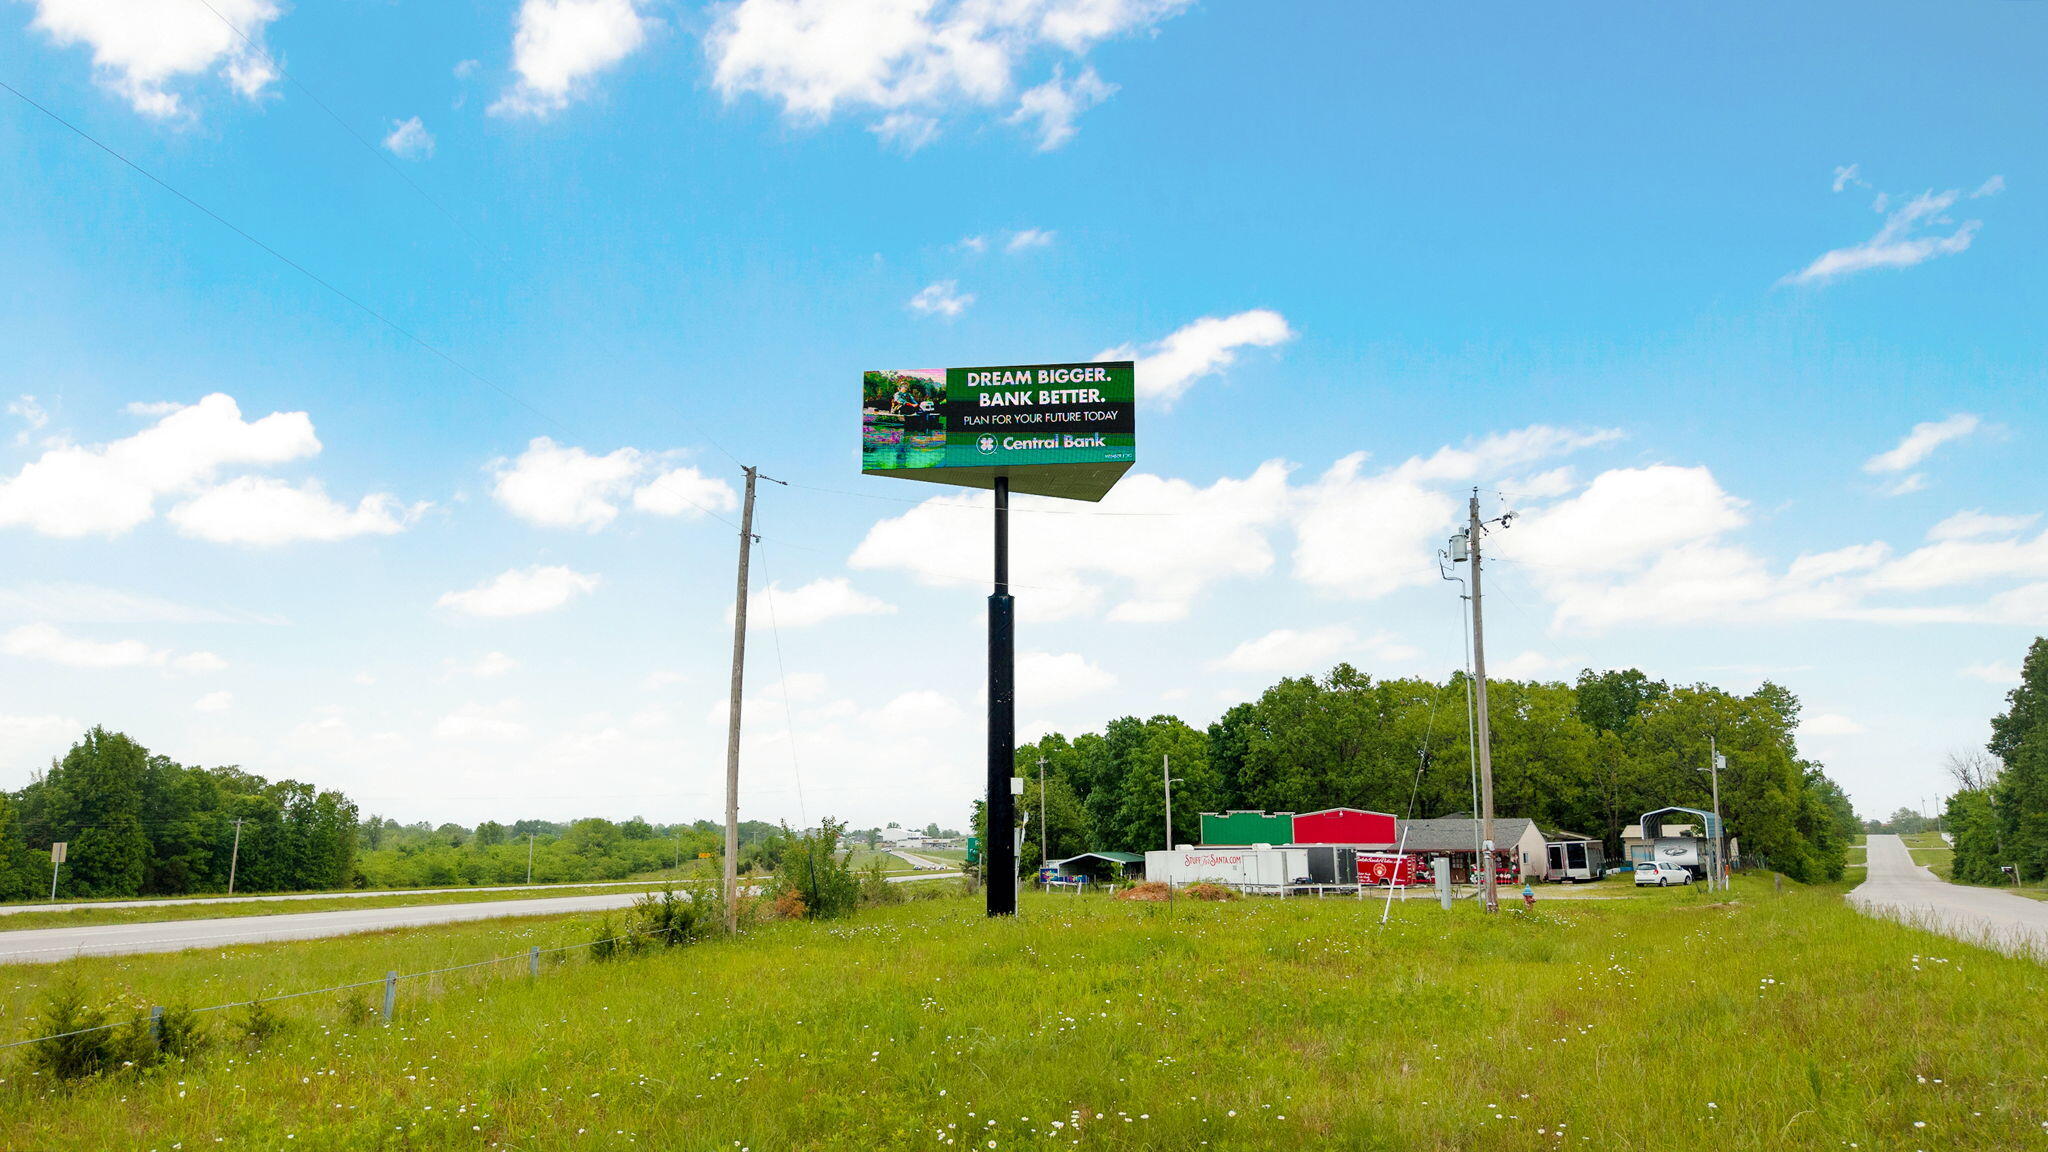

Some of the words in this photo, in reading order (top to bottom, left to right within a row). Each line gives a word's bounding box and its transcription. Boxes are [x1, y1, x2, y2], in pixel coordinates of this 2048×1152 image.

[967, 371, 1032, 386] DREAM
[1038, 368, 1111, 384] BIGGER.
[979, 391, 1033, 406] BANK
[1039, 389, 1105, 404] BETTER.
[963, 416, 989, 425] PLAN
[992, 415, 1012, 424] FOR
[1014, 413, 1042, 424] YOUR
[1045, 412, 1081, 422] FUTURE
[1084, 411, 1118, 421] TODAY
[1003, 434, 1059, 450] Central
[1064, 432, 1106, 448] Bank
